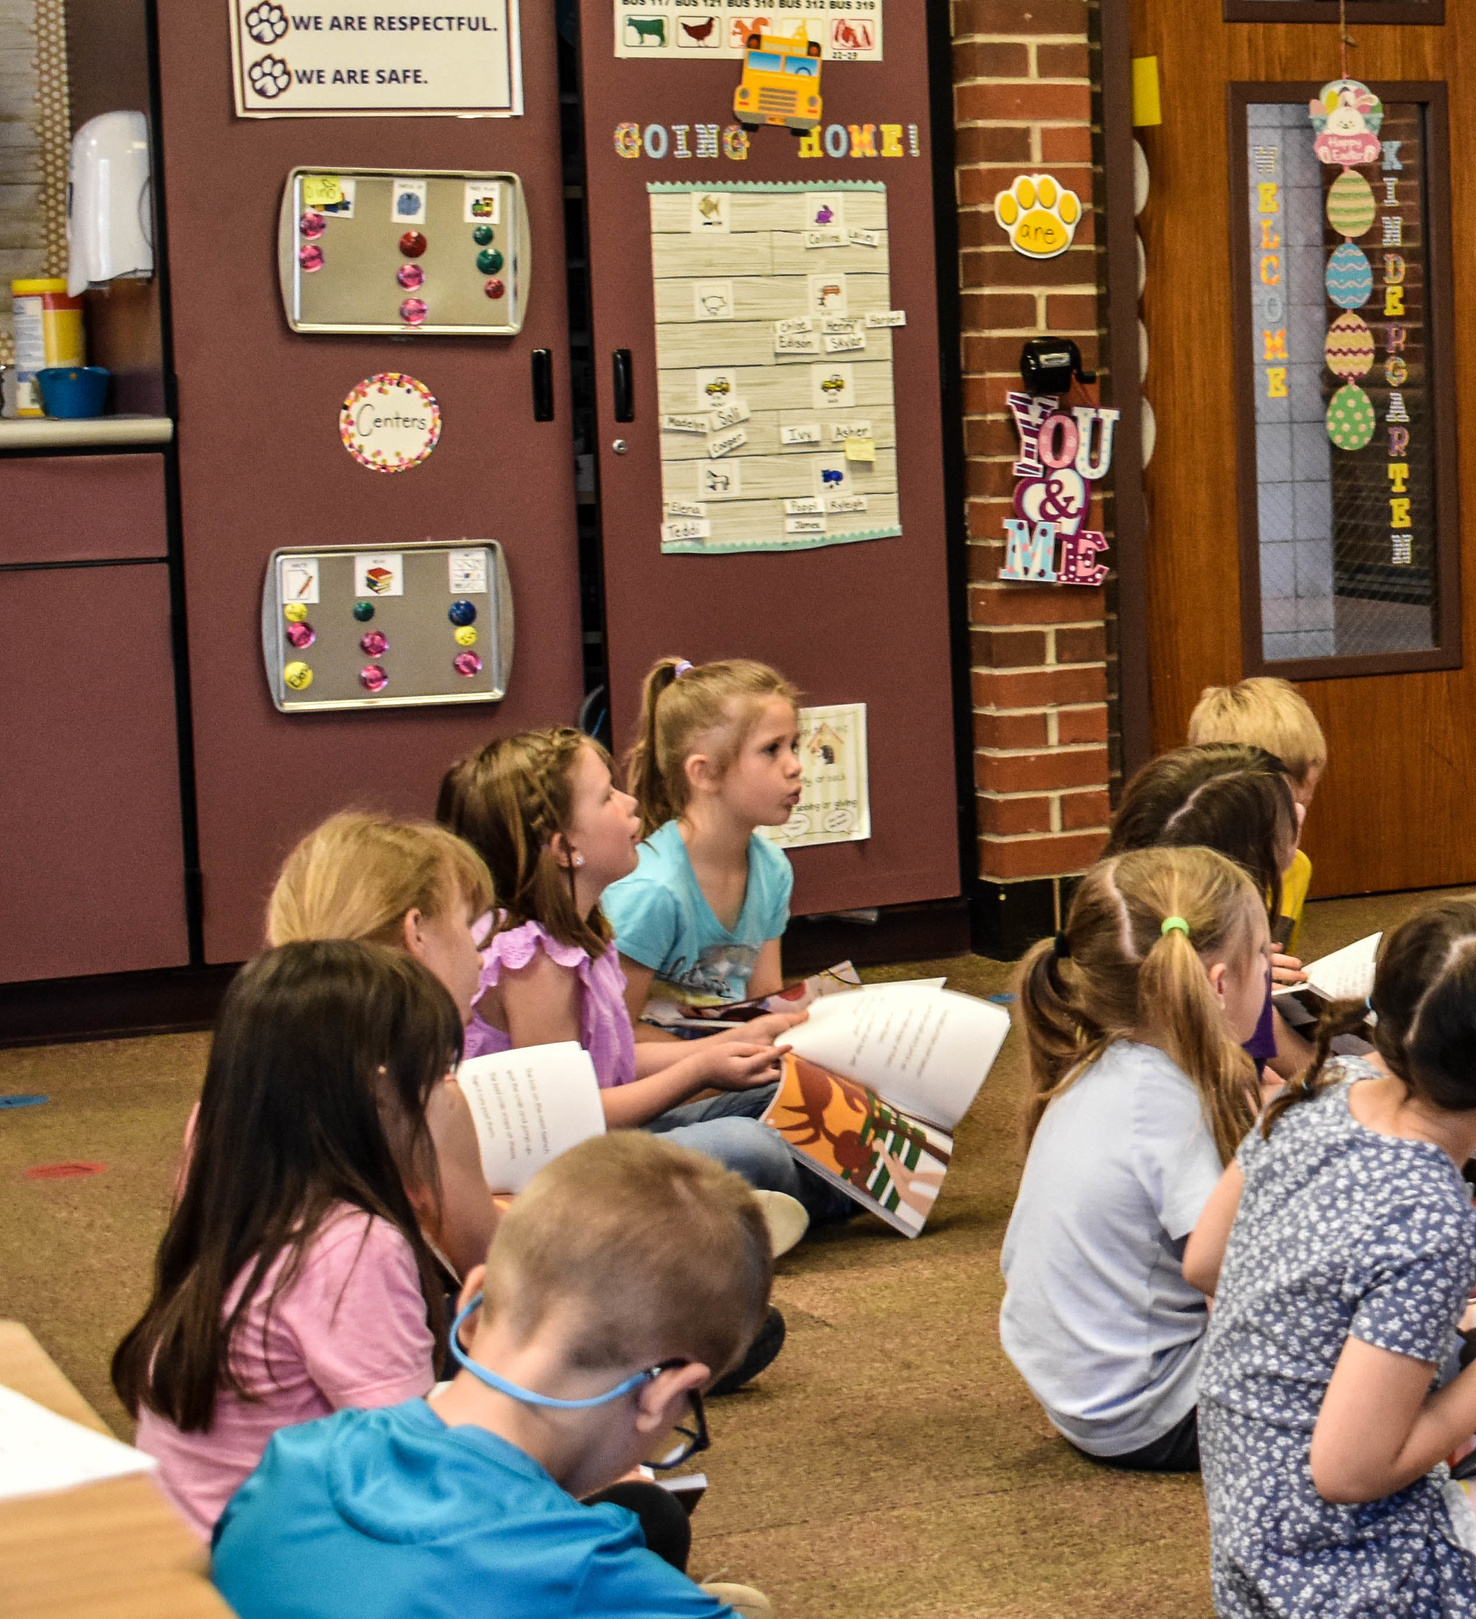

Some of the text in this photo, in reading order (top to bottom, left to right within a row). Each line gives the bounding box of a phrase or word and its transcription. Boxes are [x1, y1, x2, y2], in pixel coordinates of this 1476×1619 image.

[754, 0, 774, 8] 310
[778, 0, 825, 9] BUS 312
[830, 0, 875, 10] BUS 319
[291, 15, 498, 32] WE ARE RESPECTFUL.
[832, 52, 858, 60] 22-23
[295, 70, 428, 84] WE ARE SAFE.
[614, 122, 920, 160] GOING HOME!
[1020, 222, 1056, 246] are
[1250, 145, 1289, 398] WELCOME
[1381, 141, 1414, 564] KINDERGARTEN
[356, 403, 427, 438] Centers
[788, 428, 812, 442] Ivy
[834, 426, 868, 438] Asher
[1006, 392, 1120, 480] YOU
[1039, 478, 1082, 522] &
[998, 518, 1110, 586] ME
